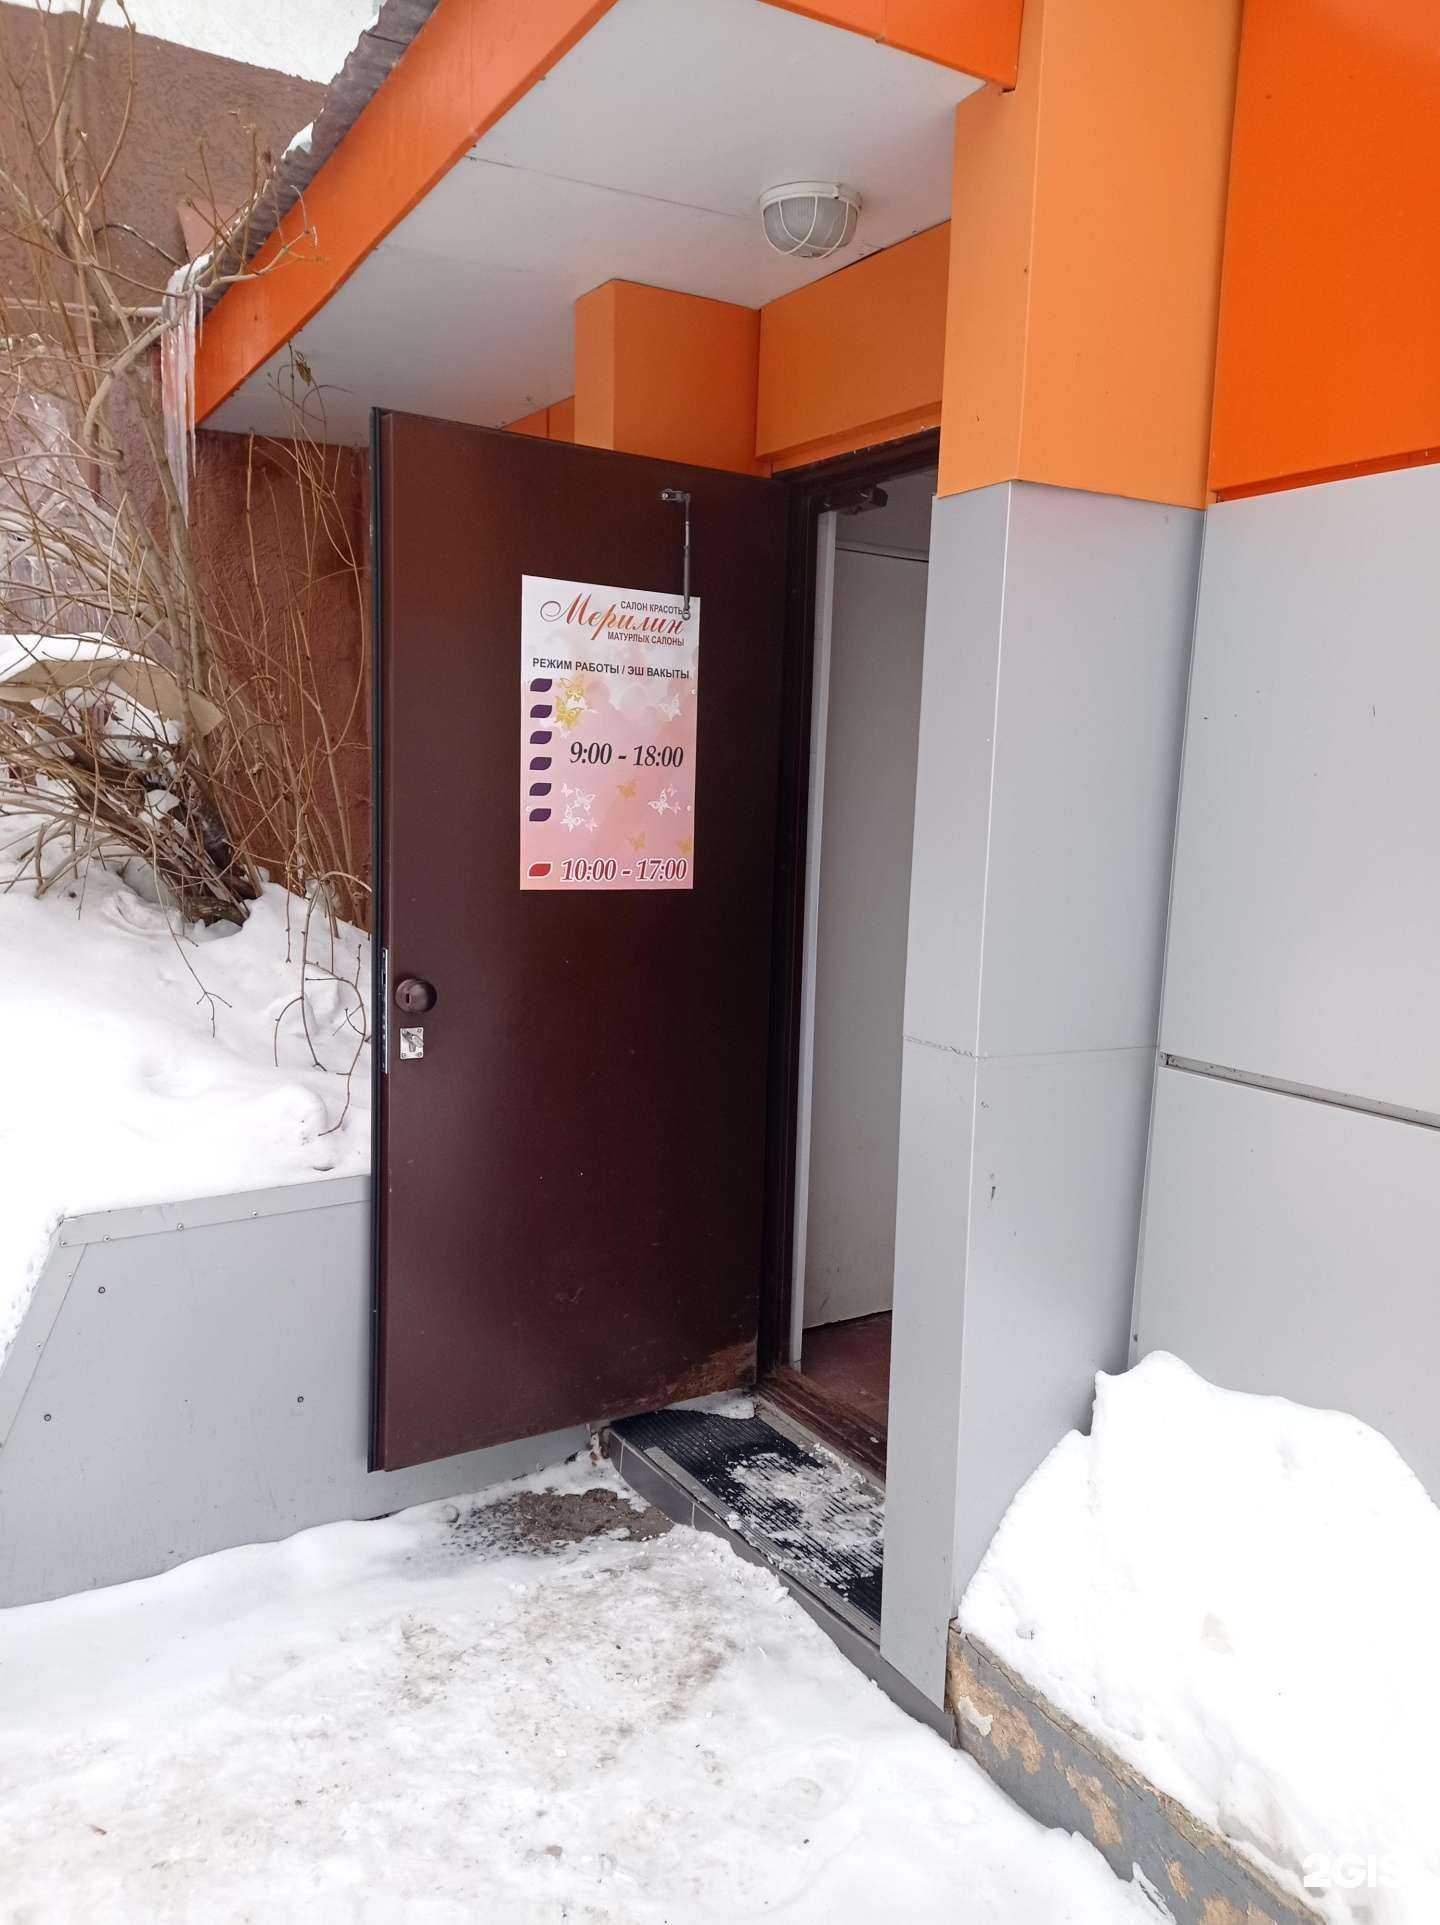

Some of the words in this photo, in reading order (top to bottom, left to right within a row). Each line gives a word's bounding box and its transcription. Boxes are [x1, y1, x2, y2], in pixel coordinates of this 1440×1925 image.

[540, 592, 685, 641] Мерилин
[620, 600, 648, 612] САЛОН
[607, 631, 650, 643] МАТУРЛЫК
[651, 634, 684, 646] САЛОНЫ
[532, 657, 572, 671] РЕЖИМ
[575, 661, 619, 674] РАБОТЫ
[627, 665, 644, 676] ЭШ
[646, 667, 689, 679] ВАКЫТЫ
[569, 741, 613, 765] 9:00
[632, 745, 684, 767] 18:00
[560, 858, 618, 882] 10:00
[635, 858, 688, 881] 17:00
